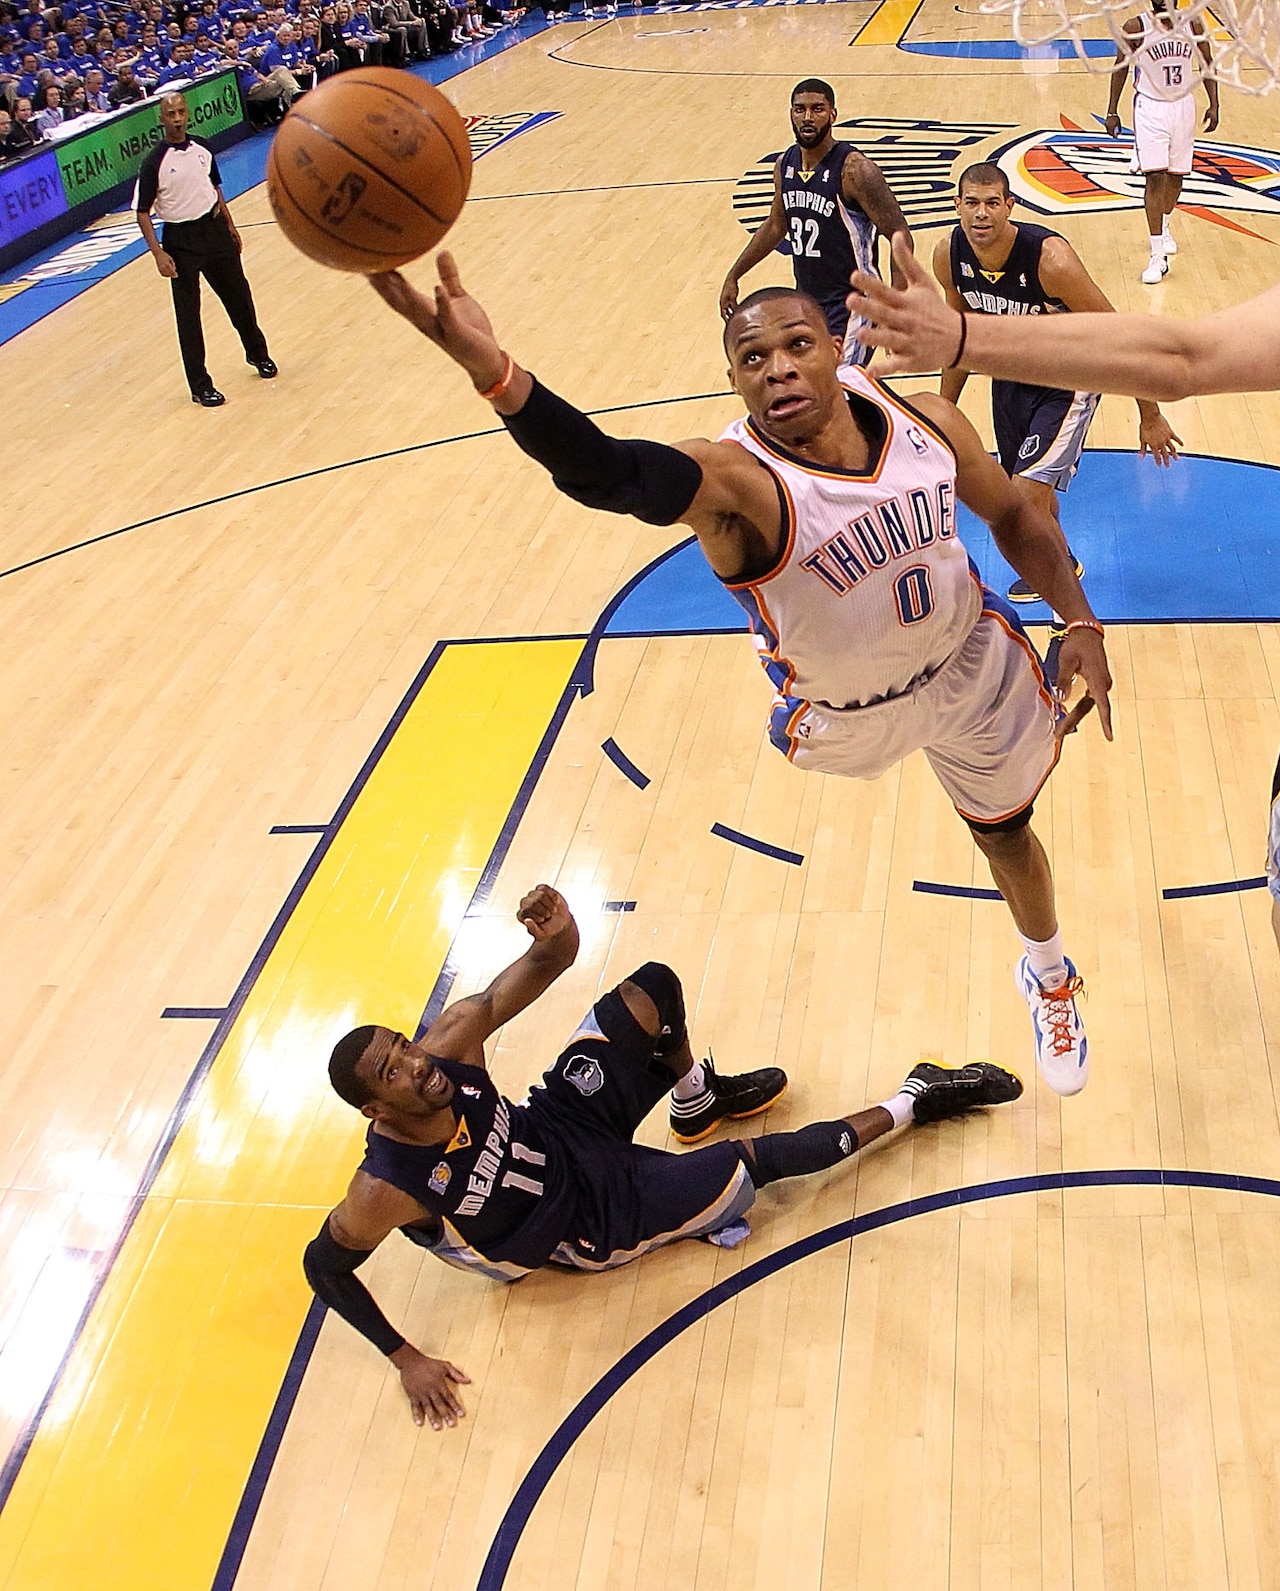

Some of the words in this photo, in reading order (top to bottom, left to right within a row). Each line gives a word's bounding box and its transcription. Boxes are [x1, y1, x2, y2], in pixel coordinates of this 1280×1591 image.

[1162, 65, 1183, 87] 13
[4, 171, 58, 220] EVERY
[62, 148, 113, 190] TEAM.
[119, 98, 224, 162] NBAST.COM
[790, 216, 821, 258] 32
[893, 563, 935, 627] 0
[501, 1142, 547, 1197] 11
